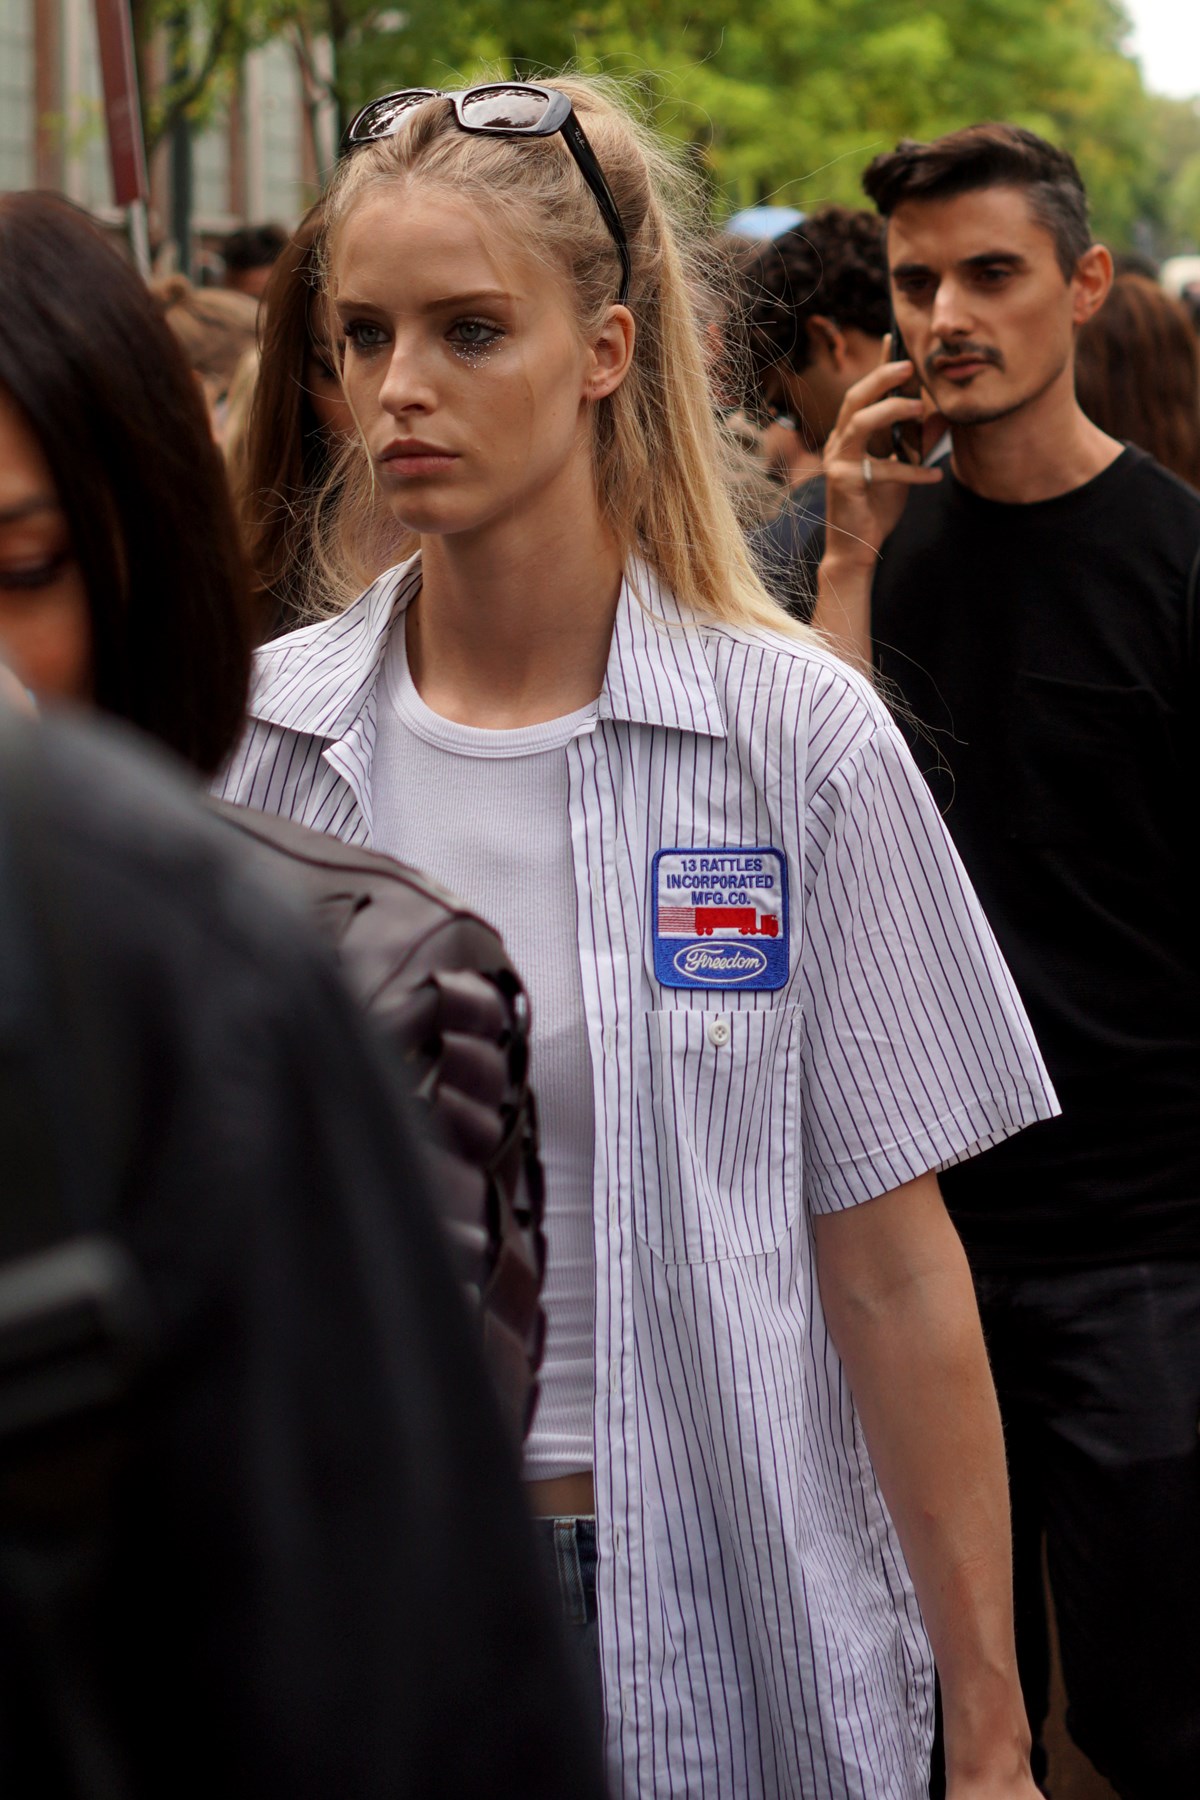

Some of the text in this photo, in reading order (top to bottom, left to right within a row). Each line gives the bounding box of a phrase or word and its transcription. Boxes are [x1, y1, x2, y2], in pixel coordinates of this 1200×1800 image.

[681, 858, 763, 872] 13 RATTLES
[666, 874, 774, 889] INCORPORATED
[684, 948, 761, 972] Freedom
